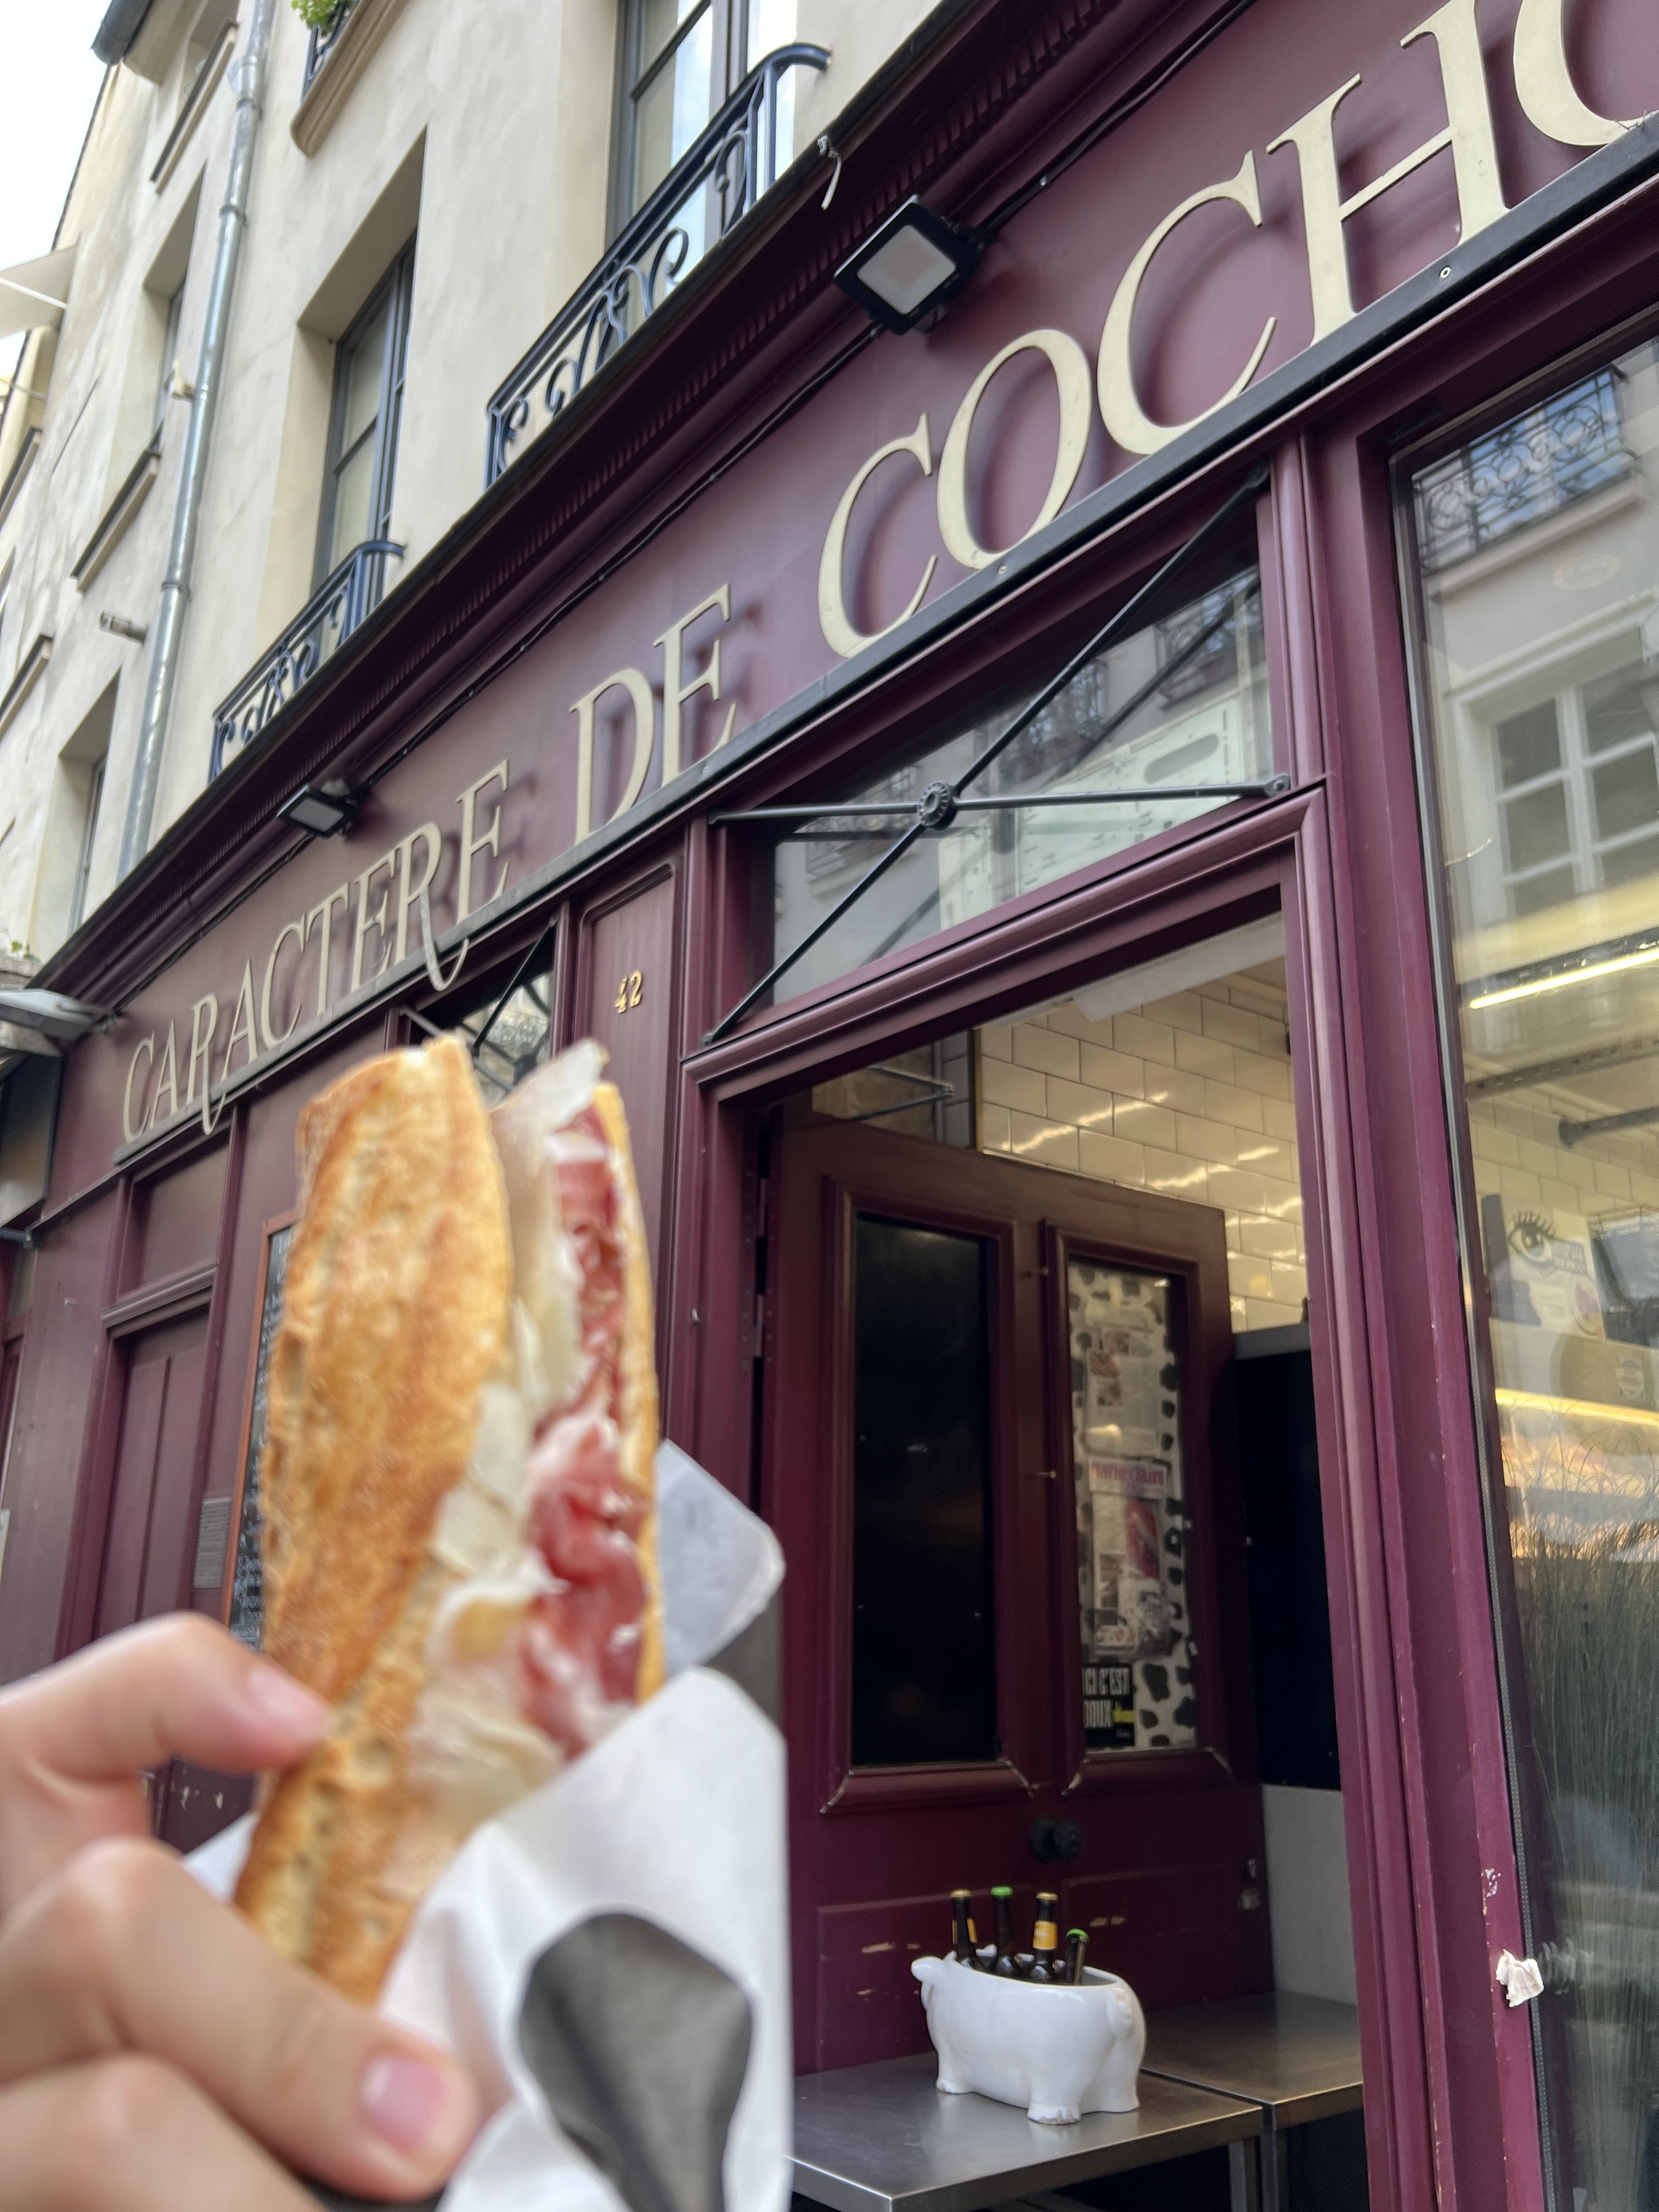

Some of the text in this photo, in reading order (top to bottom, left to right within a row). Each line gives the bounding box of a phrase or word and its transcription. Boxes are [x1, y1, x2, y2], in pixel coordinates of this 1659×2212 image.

[123, 759, 510, 1143] CARACTERE
[568, 583, 736, 846] DE
[615, 969, 642, 1014] 42
